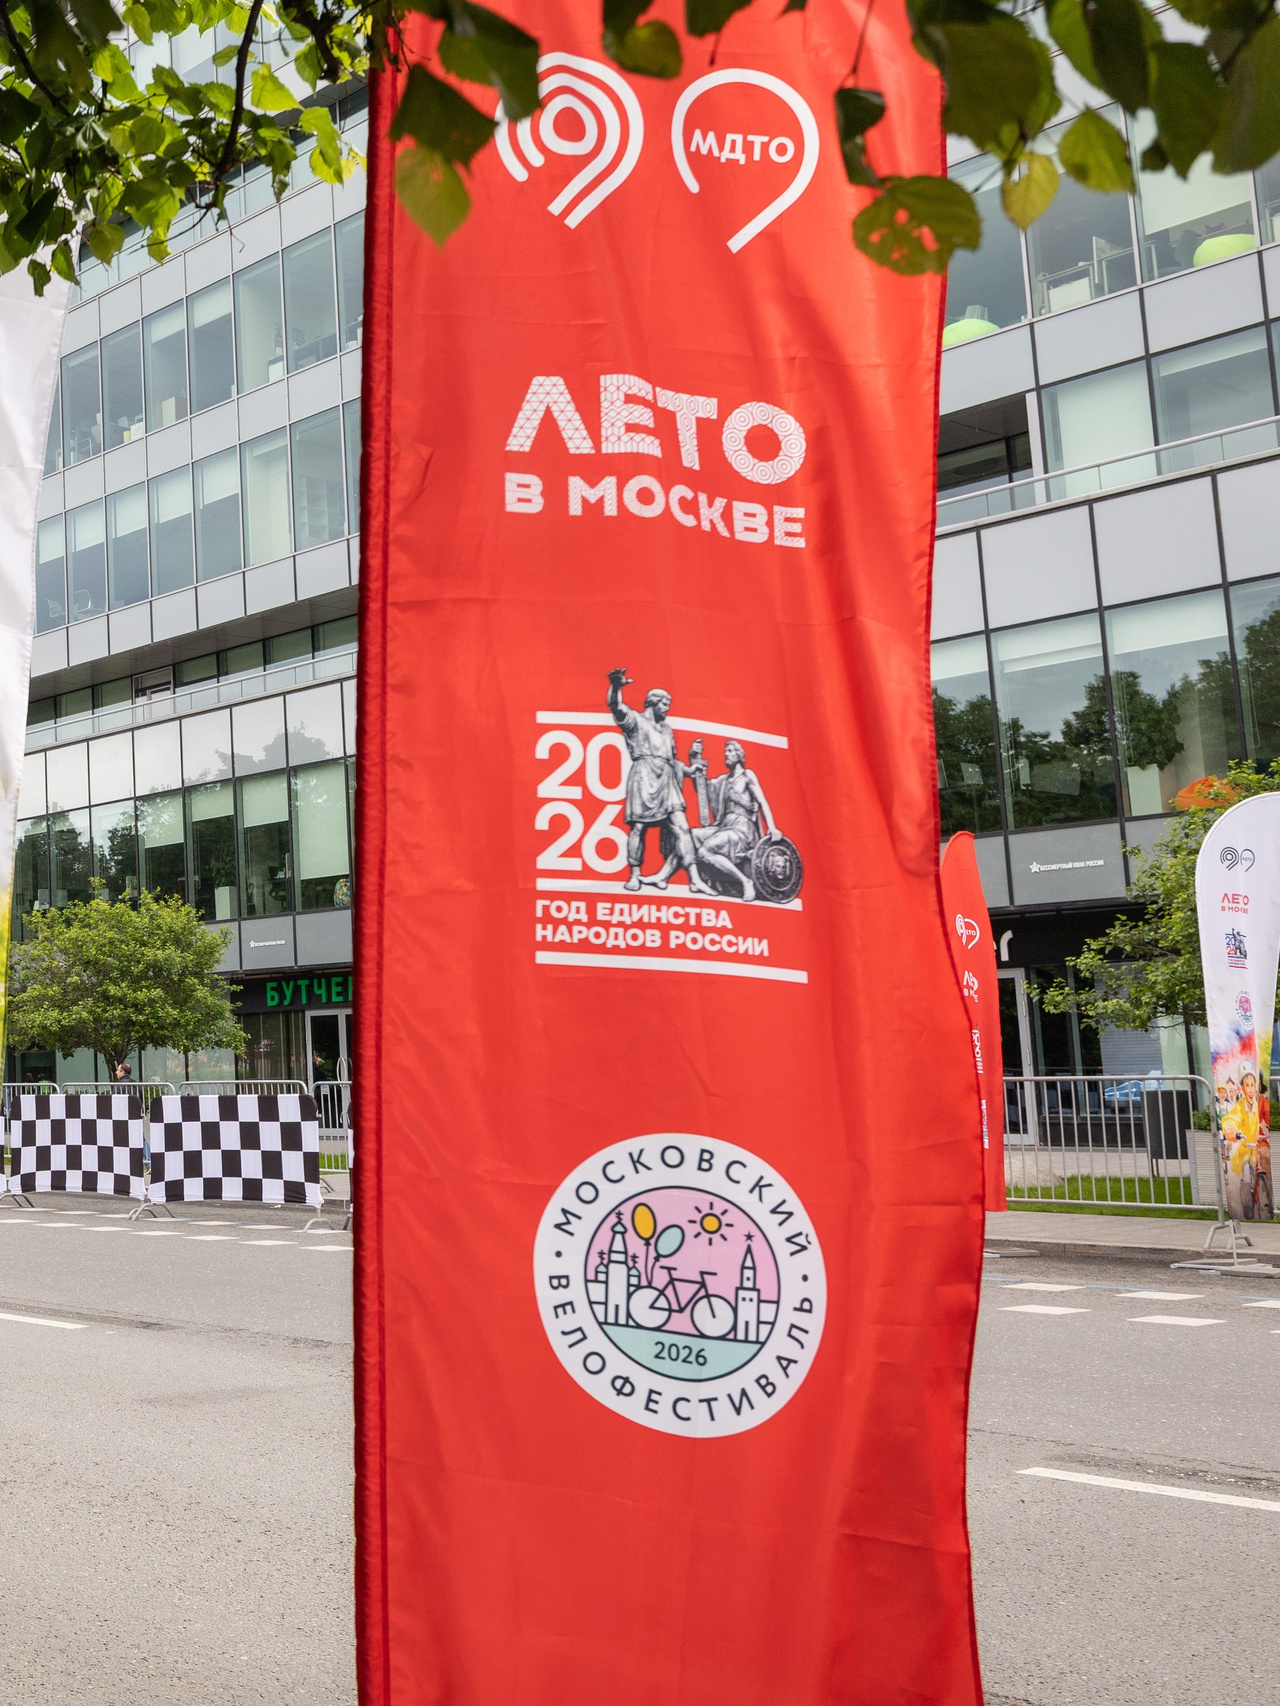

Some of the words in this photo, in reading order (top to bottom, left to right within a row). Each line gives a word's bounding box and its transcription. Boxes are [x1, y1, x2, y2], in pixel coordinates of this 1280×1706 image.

[690, 128, 794, 164] МДТО
[505, 374, 806, 485] ЛЕТО
[505, 472, 544, 513] В
[568, 474, 805, 548] МОСКВЕ
[535, 730, 627, 802] 20
[535, 801, 628, 874] 26
[535, 923, 662, 949] НАРОДОВ
[669, 931, 769, 957] РОССИИ
[536, 900, 587, 924] ГОД
[596, 901, 732, 929] ЕДИНСТВА
[553, 1145, 812, 1257] МОСКОВСКИЙ
[549, 1274, 814, 1421] ВЕЛОФЕСТИВАЛЬ
[654, 1341, 708, 1367] 2026
